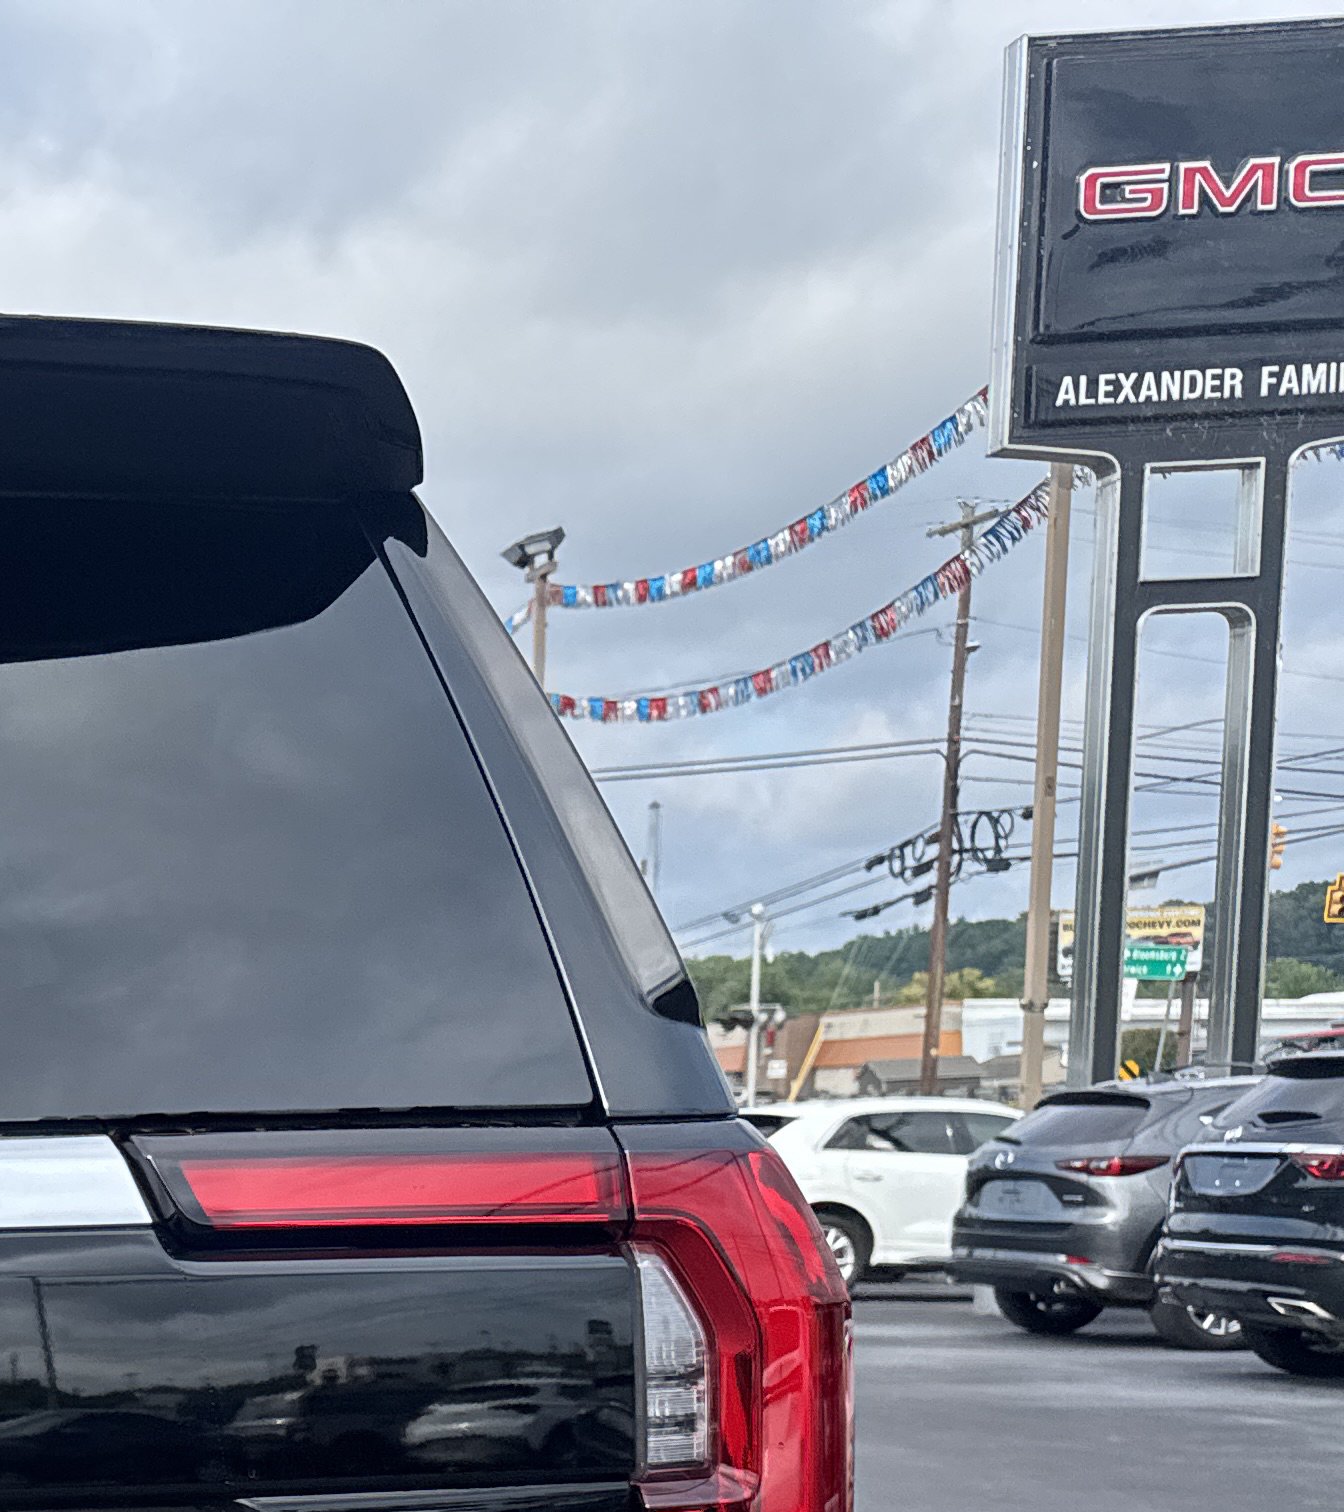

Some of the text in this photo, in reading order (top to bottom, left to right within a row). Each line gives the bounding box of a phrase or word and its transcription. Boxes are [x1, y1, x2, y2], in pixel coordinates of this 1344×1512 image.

[1079, 152, 1344, 220] GMC
[1055, 362, 1344, 407] ALEXANDER FAMI
